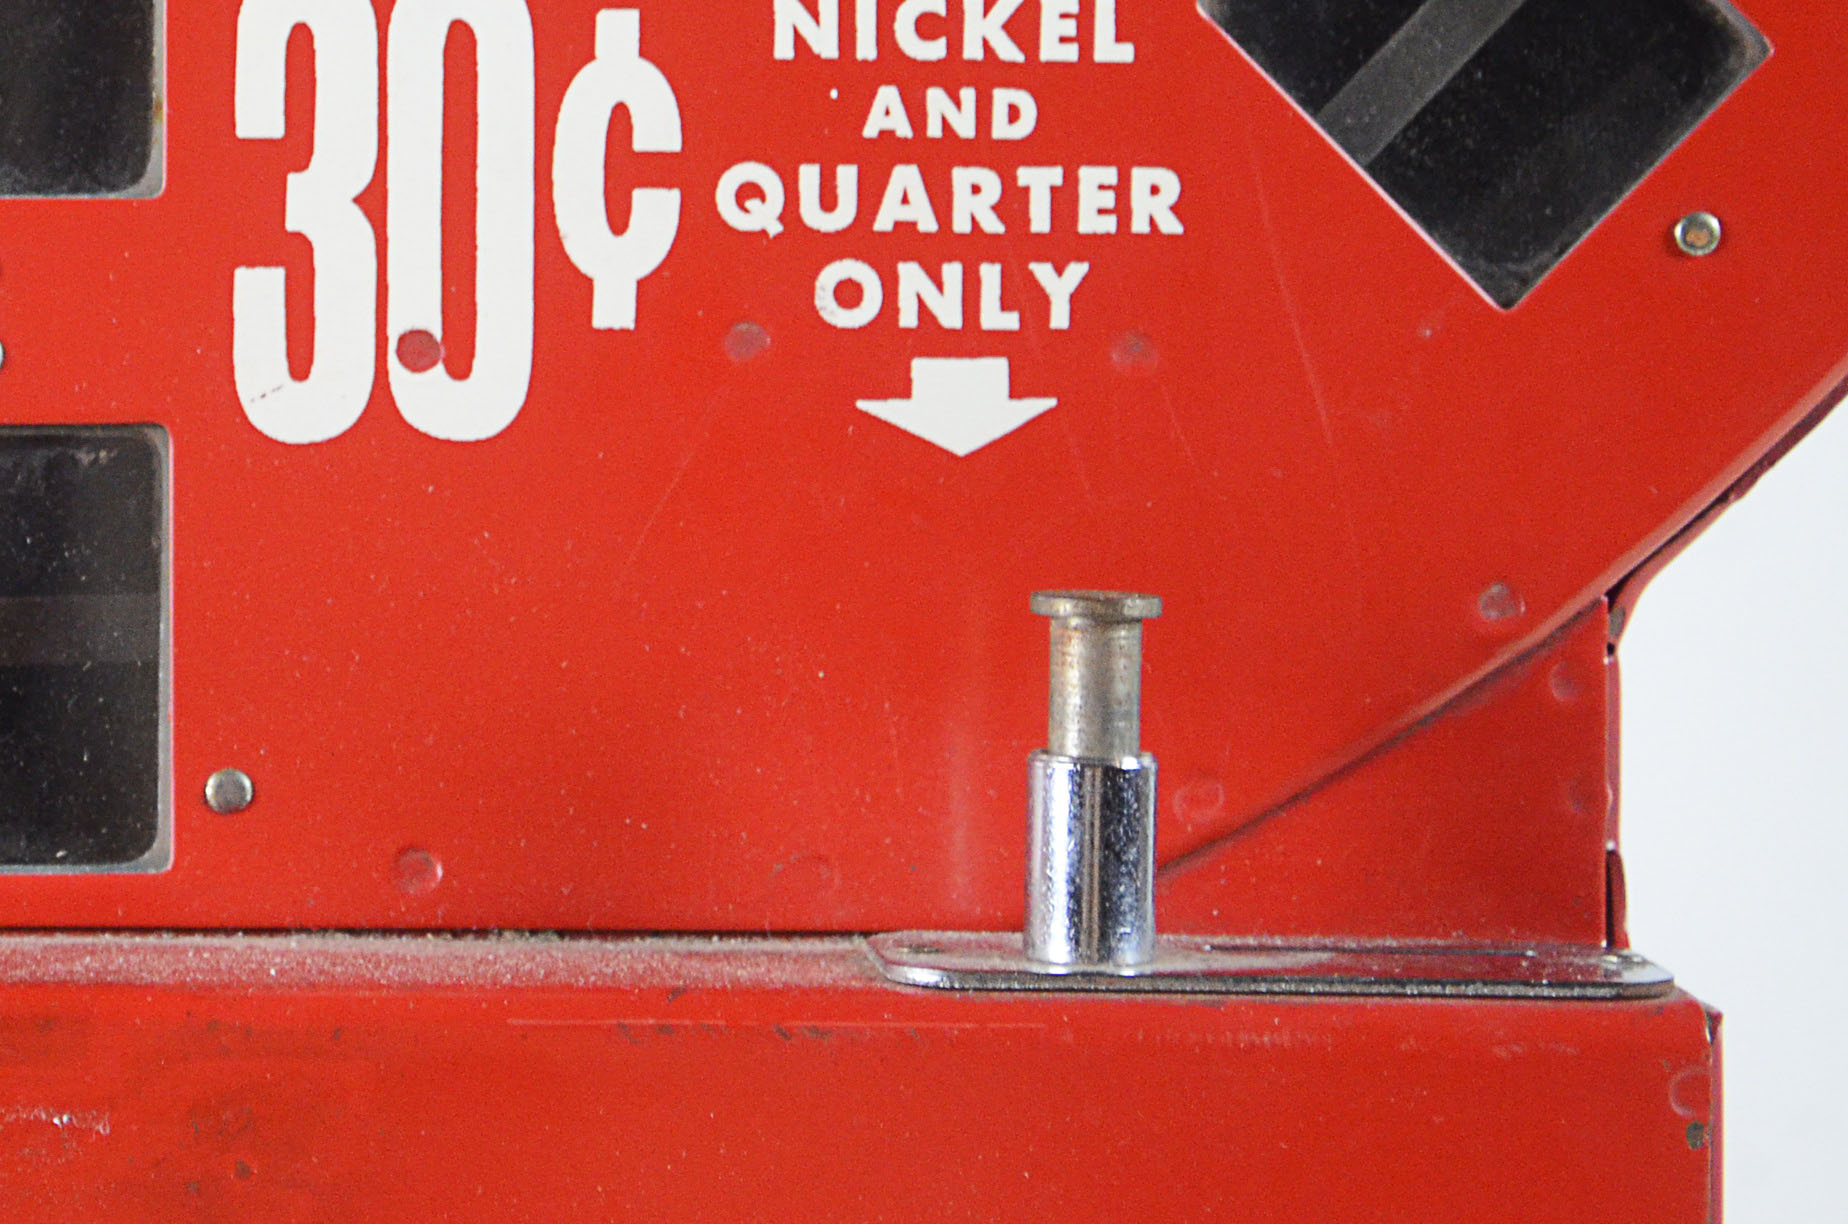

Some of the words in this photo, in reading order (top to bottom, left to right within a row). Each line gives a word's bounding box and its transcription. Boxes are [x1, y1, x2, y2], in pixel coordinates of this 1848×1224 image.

[862, 84, 1038, 141] AND
[715, 161, 1184, 239] QUARTER
[814, 257, 1090, 331] ONLY
